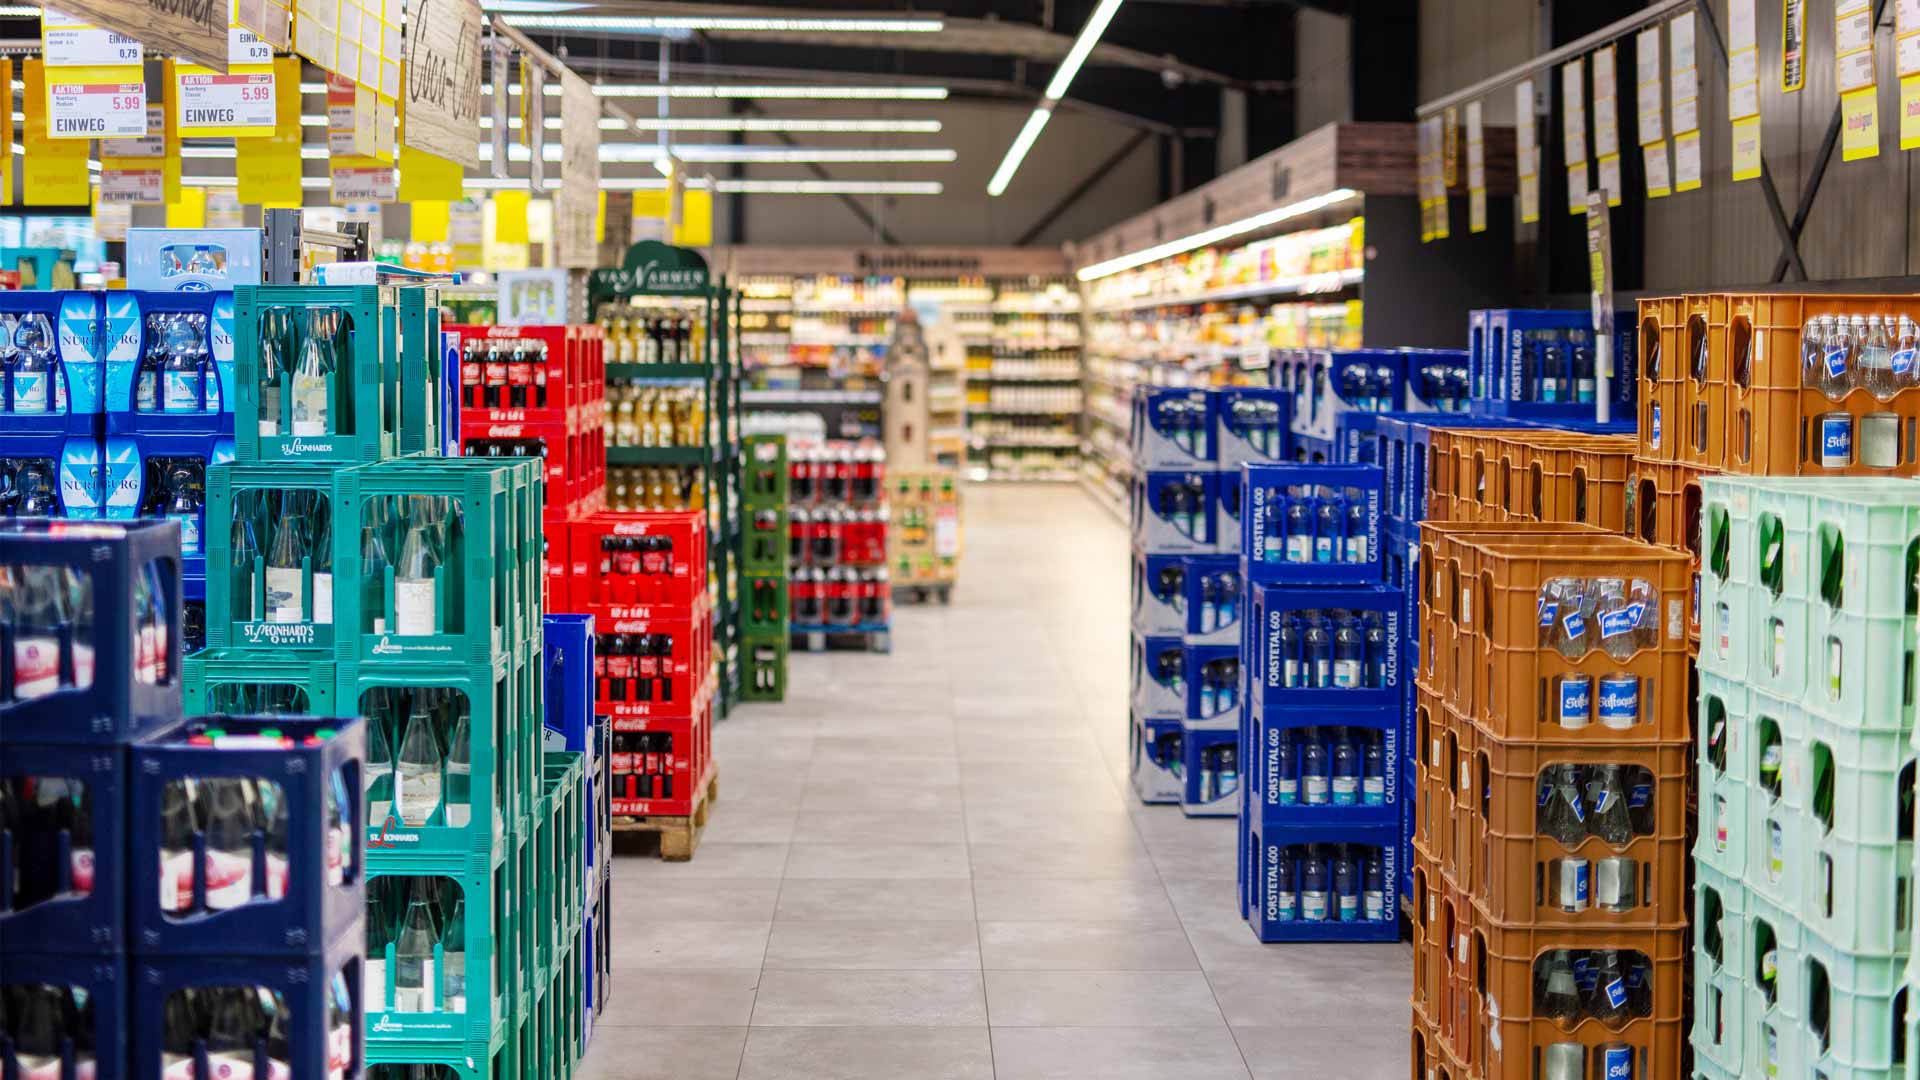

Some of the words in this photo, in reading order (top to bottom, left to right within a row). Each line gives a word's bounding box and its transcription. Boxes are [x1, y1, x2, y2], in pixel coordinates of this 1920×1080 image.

[55, 85, 84, 94] AKTION
[184, 75, 213, 85] AKTION
[113, 96, 140, 110] 5.99
[242, 87, 269, 100] 5.99
[56, 118, 105, 132] EINWEG
[185, 109, 234, 122] EINWEG
[1254, 487, 1265, 502] 600
[1253, 503, 1265, 561] FORSTETAL
[1368, 489, 1379, 562] CALCIUMQUELLE
[1270, 611, 1281, 629] 600
[270, 636, 314, 644] Quelle
[1387, 611, 1398, 686] CALCIUMQUELLE
[1269, 630, 1280, 687] FORSTETAL
[1269, 728, 1280, 747] 600
[1386, 728, 1396, 804] CALCIUMQUELLE
[1268, 748, 1279, 804] FORSTETAL
[1267, 846, 1278, 865] 600
[1384, 846, 1395, 921] CALCIUMQUELLE
[1267, 866, 1278, 921] FORSTETAL
